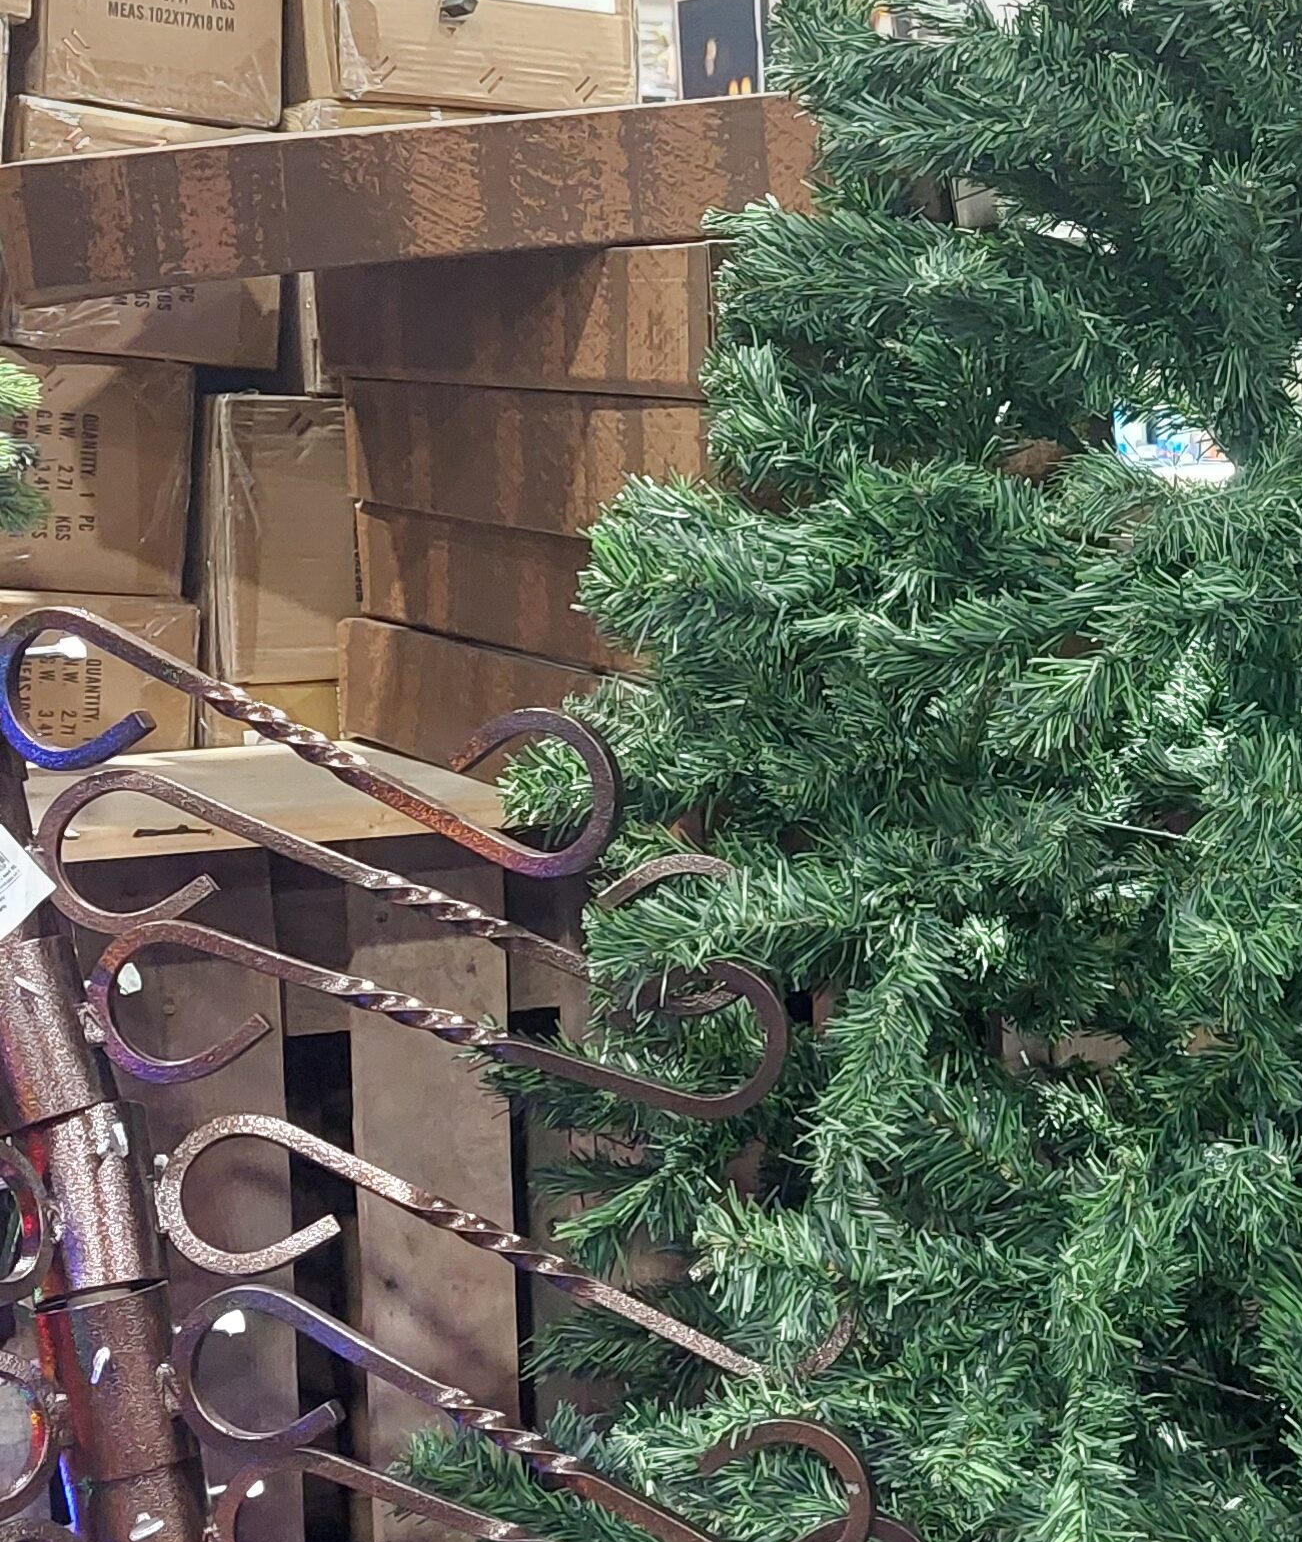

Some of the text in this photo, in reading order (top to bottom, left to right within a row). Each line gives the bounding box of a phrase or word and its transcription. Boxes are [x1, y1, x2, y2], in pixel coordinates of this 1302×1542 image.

[215, 16, 235, 33] CM
[35, 410, 52, 438] G.W.
[55, 412, 76, 542] N.W. 2.71 KGS
[78, 515, 95, 532] PC
[38, 710, 54, 737] 3.41
[60, 709, 77, 736] 2.71
